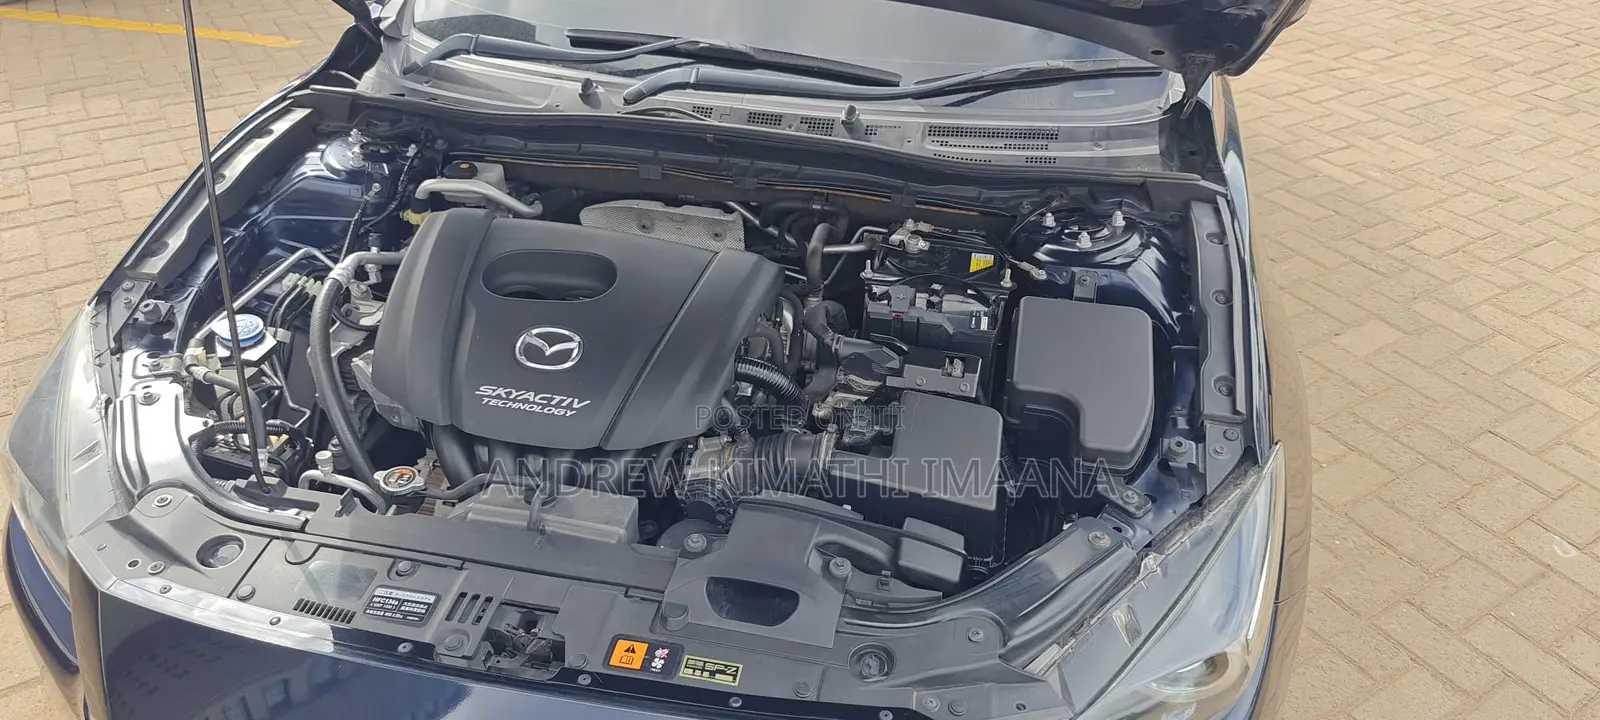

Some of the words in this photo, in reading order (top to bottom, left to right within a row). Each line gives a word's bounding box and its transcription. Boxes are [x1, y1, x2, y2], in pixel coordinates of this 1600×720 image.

[475, 385, 592, 409] SKYACTIV
[481, 397, 578, 417] TECHNOLOGY
[704, 662, 738, 675] SP-Z
